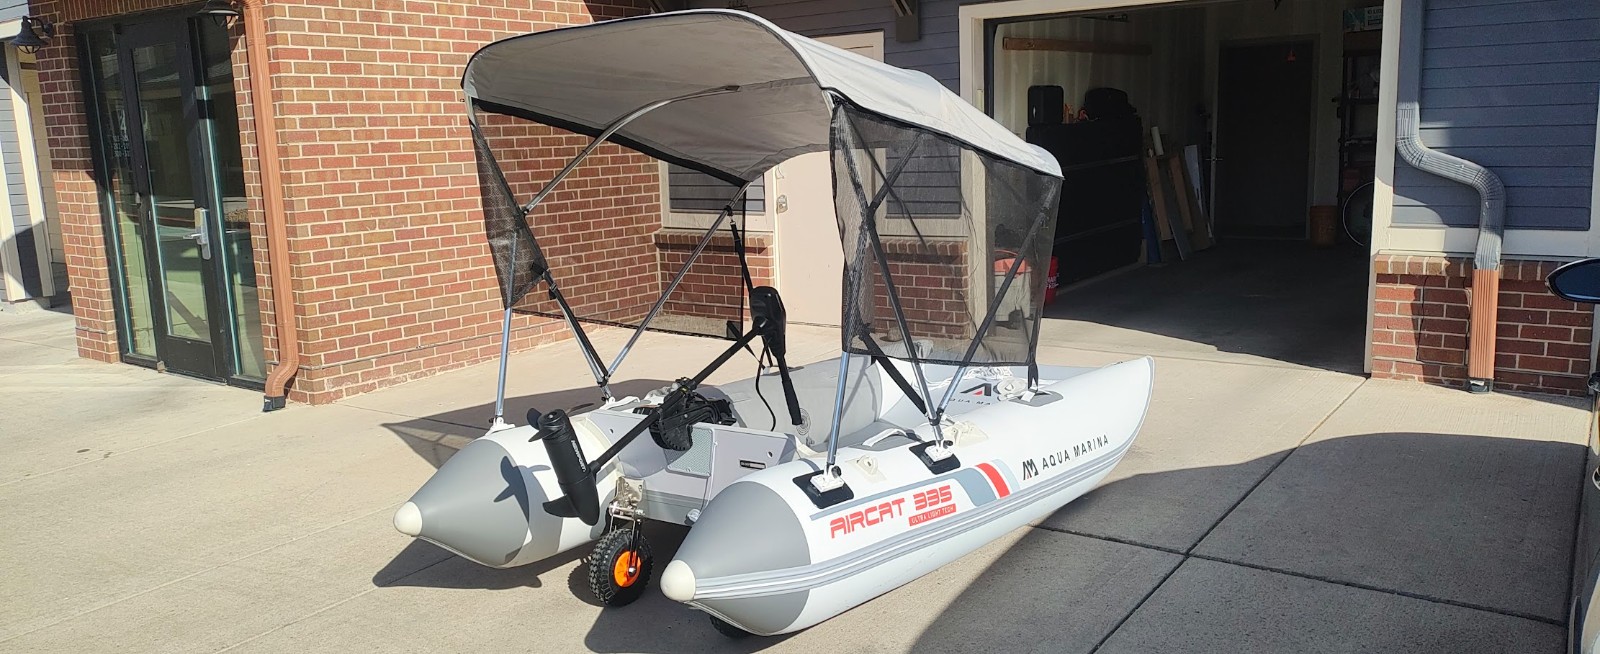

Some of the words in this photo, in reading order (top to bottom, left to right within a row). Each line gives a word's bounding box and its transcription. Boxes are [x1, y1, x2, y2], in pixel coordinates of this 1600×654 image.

[571, 440, 587, 472] NEWPORT
[1042, 449, 1071, 470] AQUA
[1073, 434, 1109, 458] MARINA
[829, 498, 905, 539] AIRCAT
[913, 485, 953, 511] 335
[911, 515, 927, 524] ULTRA
[927, 511, 941, 519] LIGHT
[941, 506, 954, 514] TECH
